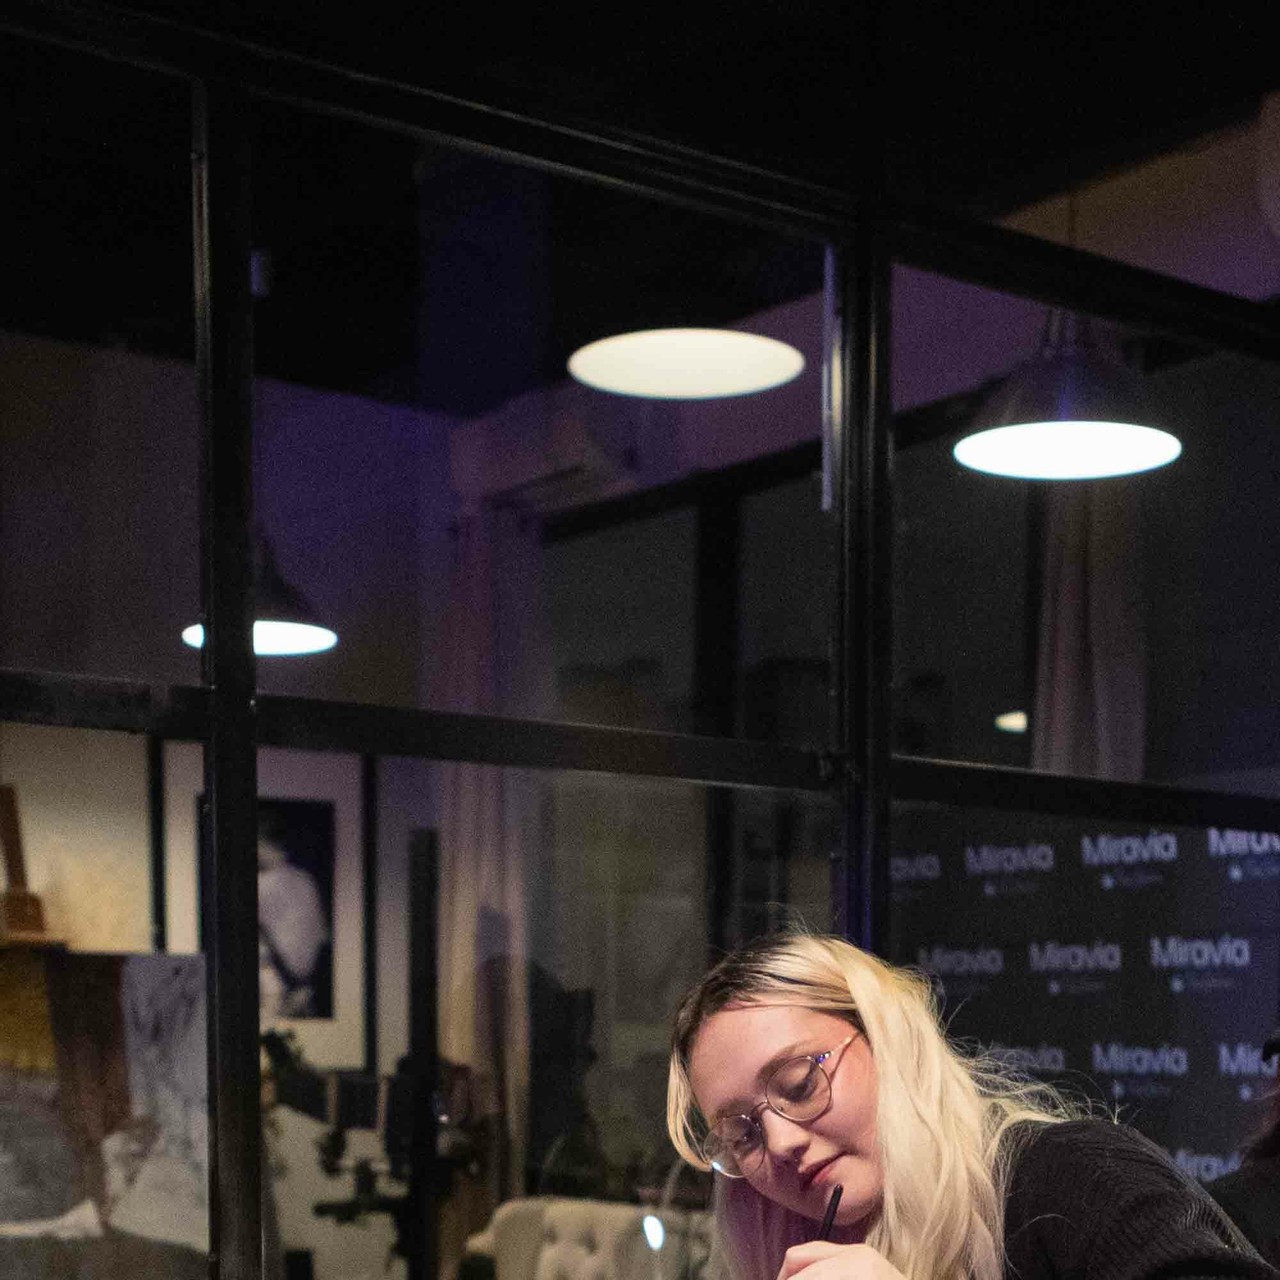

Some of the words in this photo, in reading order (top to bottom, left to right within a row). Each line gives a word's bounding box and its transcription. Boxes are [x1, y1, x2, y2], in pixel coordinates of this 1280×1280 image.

[964, 844, 1055, 873] Miravia
[1081, 829, 1178, 866] Miravia
[1028, 939, 1121, 972] Miravia
[1149, 934, 1250, 968] Miravia
[1091, 1042, 1188, 1076] Miravia
